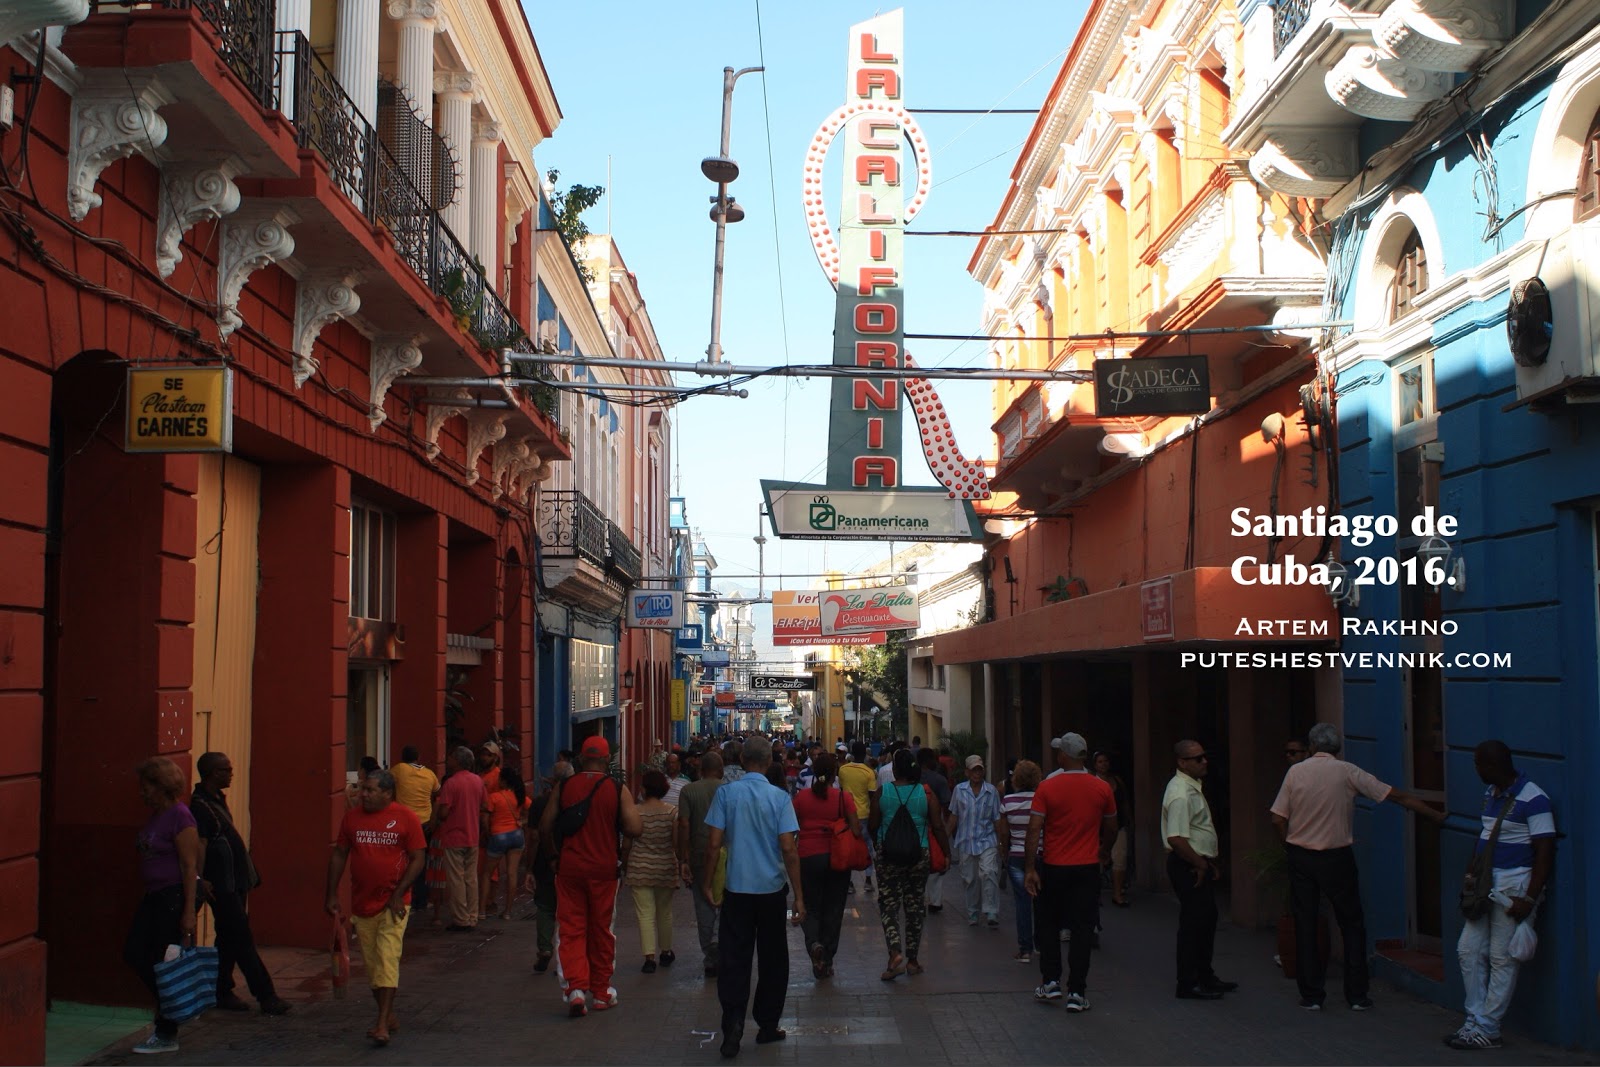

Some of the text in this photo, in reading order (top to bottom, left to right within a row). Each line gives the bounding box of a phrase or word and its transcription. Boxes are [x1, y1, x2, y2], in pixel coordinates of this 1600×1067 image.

[853, 33, 899, 488] LA CALIFORNIA
[164, 378, 184, 390] SE
[141, 392, 206, 413] Plastican
[137, 414, 208, 437] CARNÉS
[837, 515, 929, 527] Panamericana
[652, 596, 671, 610] TRD
[841, 591, 914, 611] La Dalia
[776, 616, 820, 630] El Rápi
[842, 613, 890, 625] Restaurante
[755, 677, 807, 688] El Encanto
[356, 830, 399, 839] SWISS CITY
[356, 836, 398, 845] MARATHON
